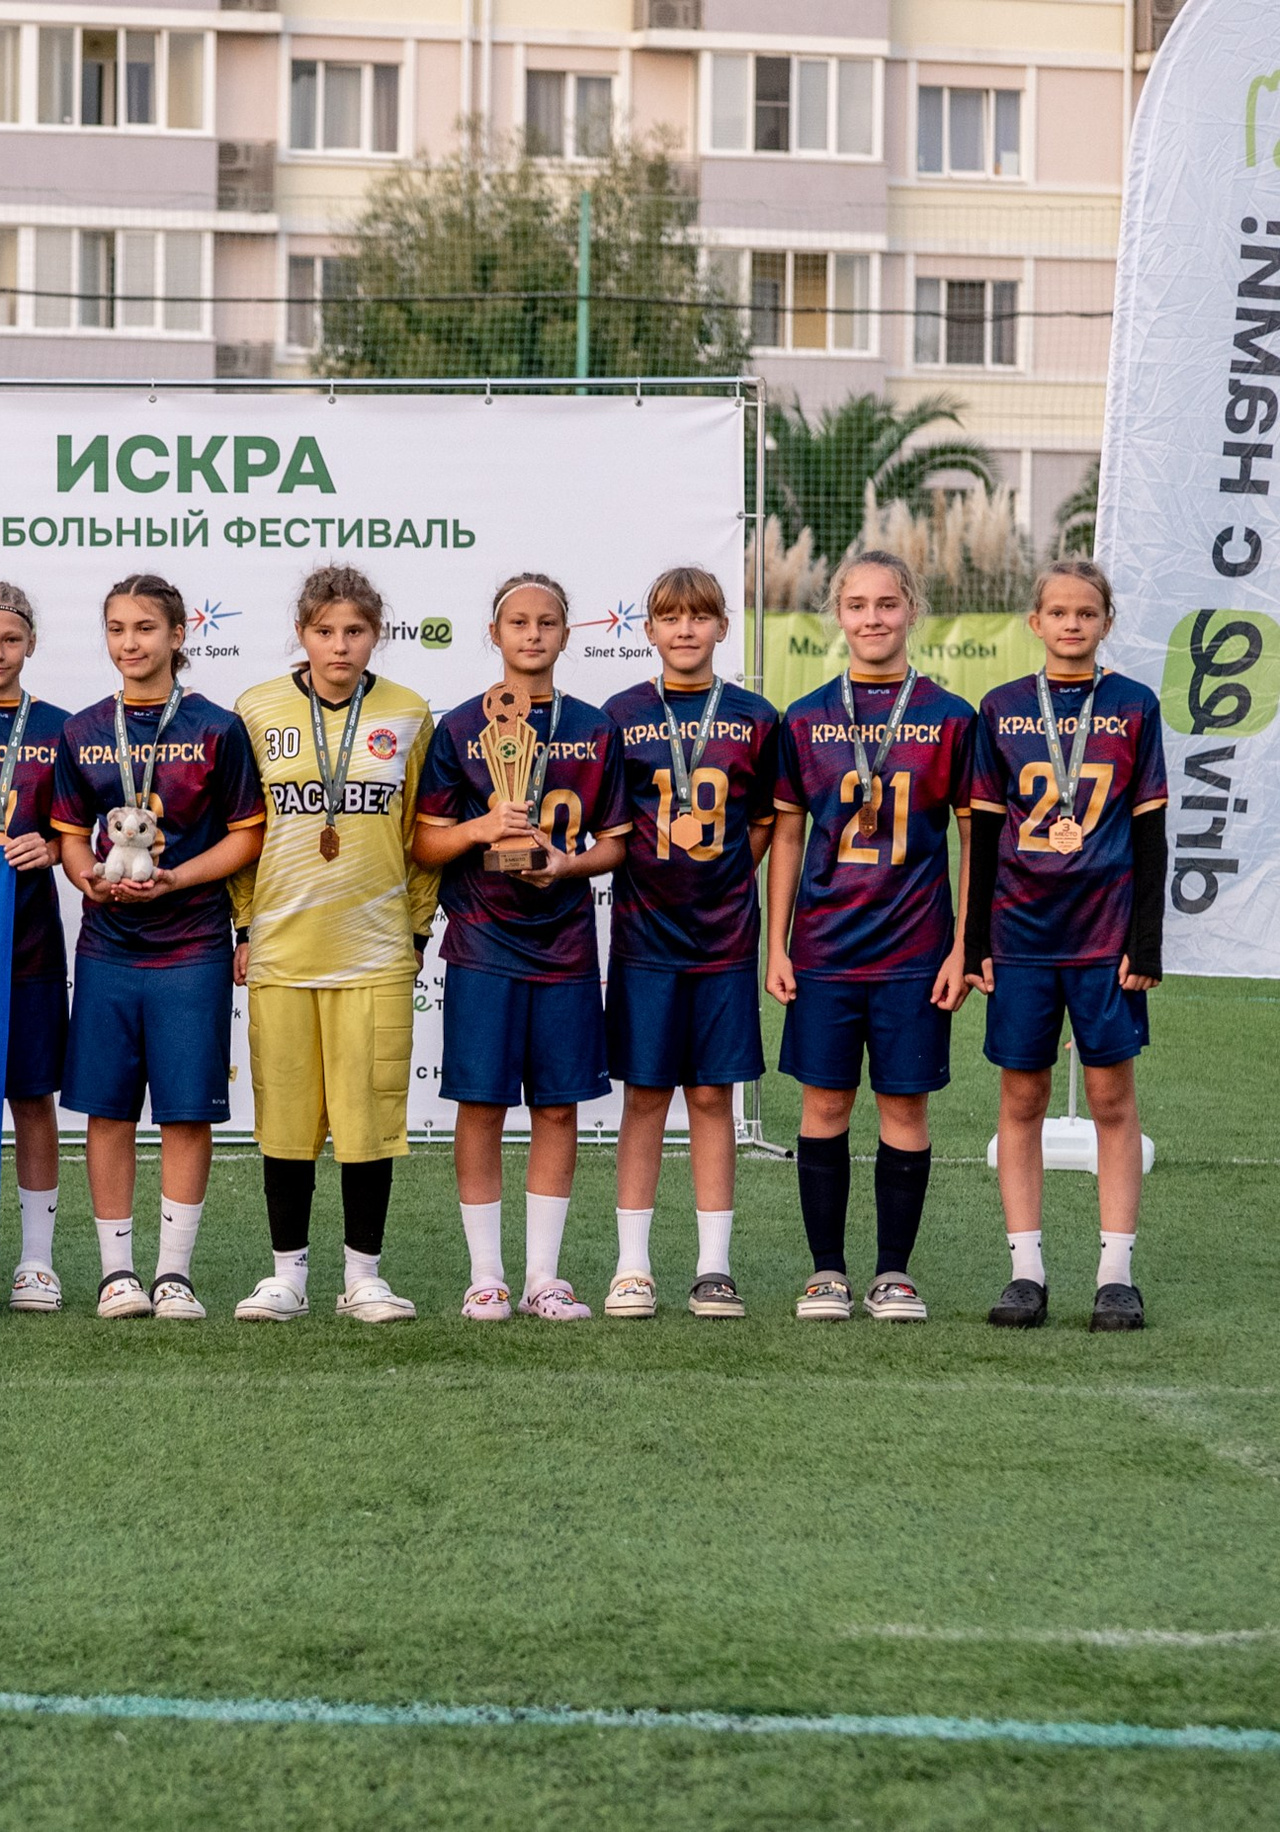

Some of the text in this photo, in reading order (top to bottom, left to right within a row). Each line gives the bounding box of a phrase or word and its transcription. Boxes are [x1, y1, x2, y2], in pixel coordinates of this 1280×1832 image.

[57, 434, 337, 494] ИСКРА
[223, 516, 476, 548] ФЕСТИВАЛЬ
[205, 645, 240, 659] Spark
[584, 646, 653, 660] Sinet Spark
[922, 639, 997, 658] чтобы
[265, 727, 301, 761] 30
[651, 767, 729, 862] 19
[837, 770, 911, 866] 21
[1017, 761, 1114, 853] 27
[1062, 823, 1070, 832] 3
